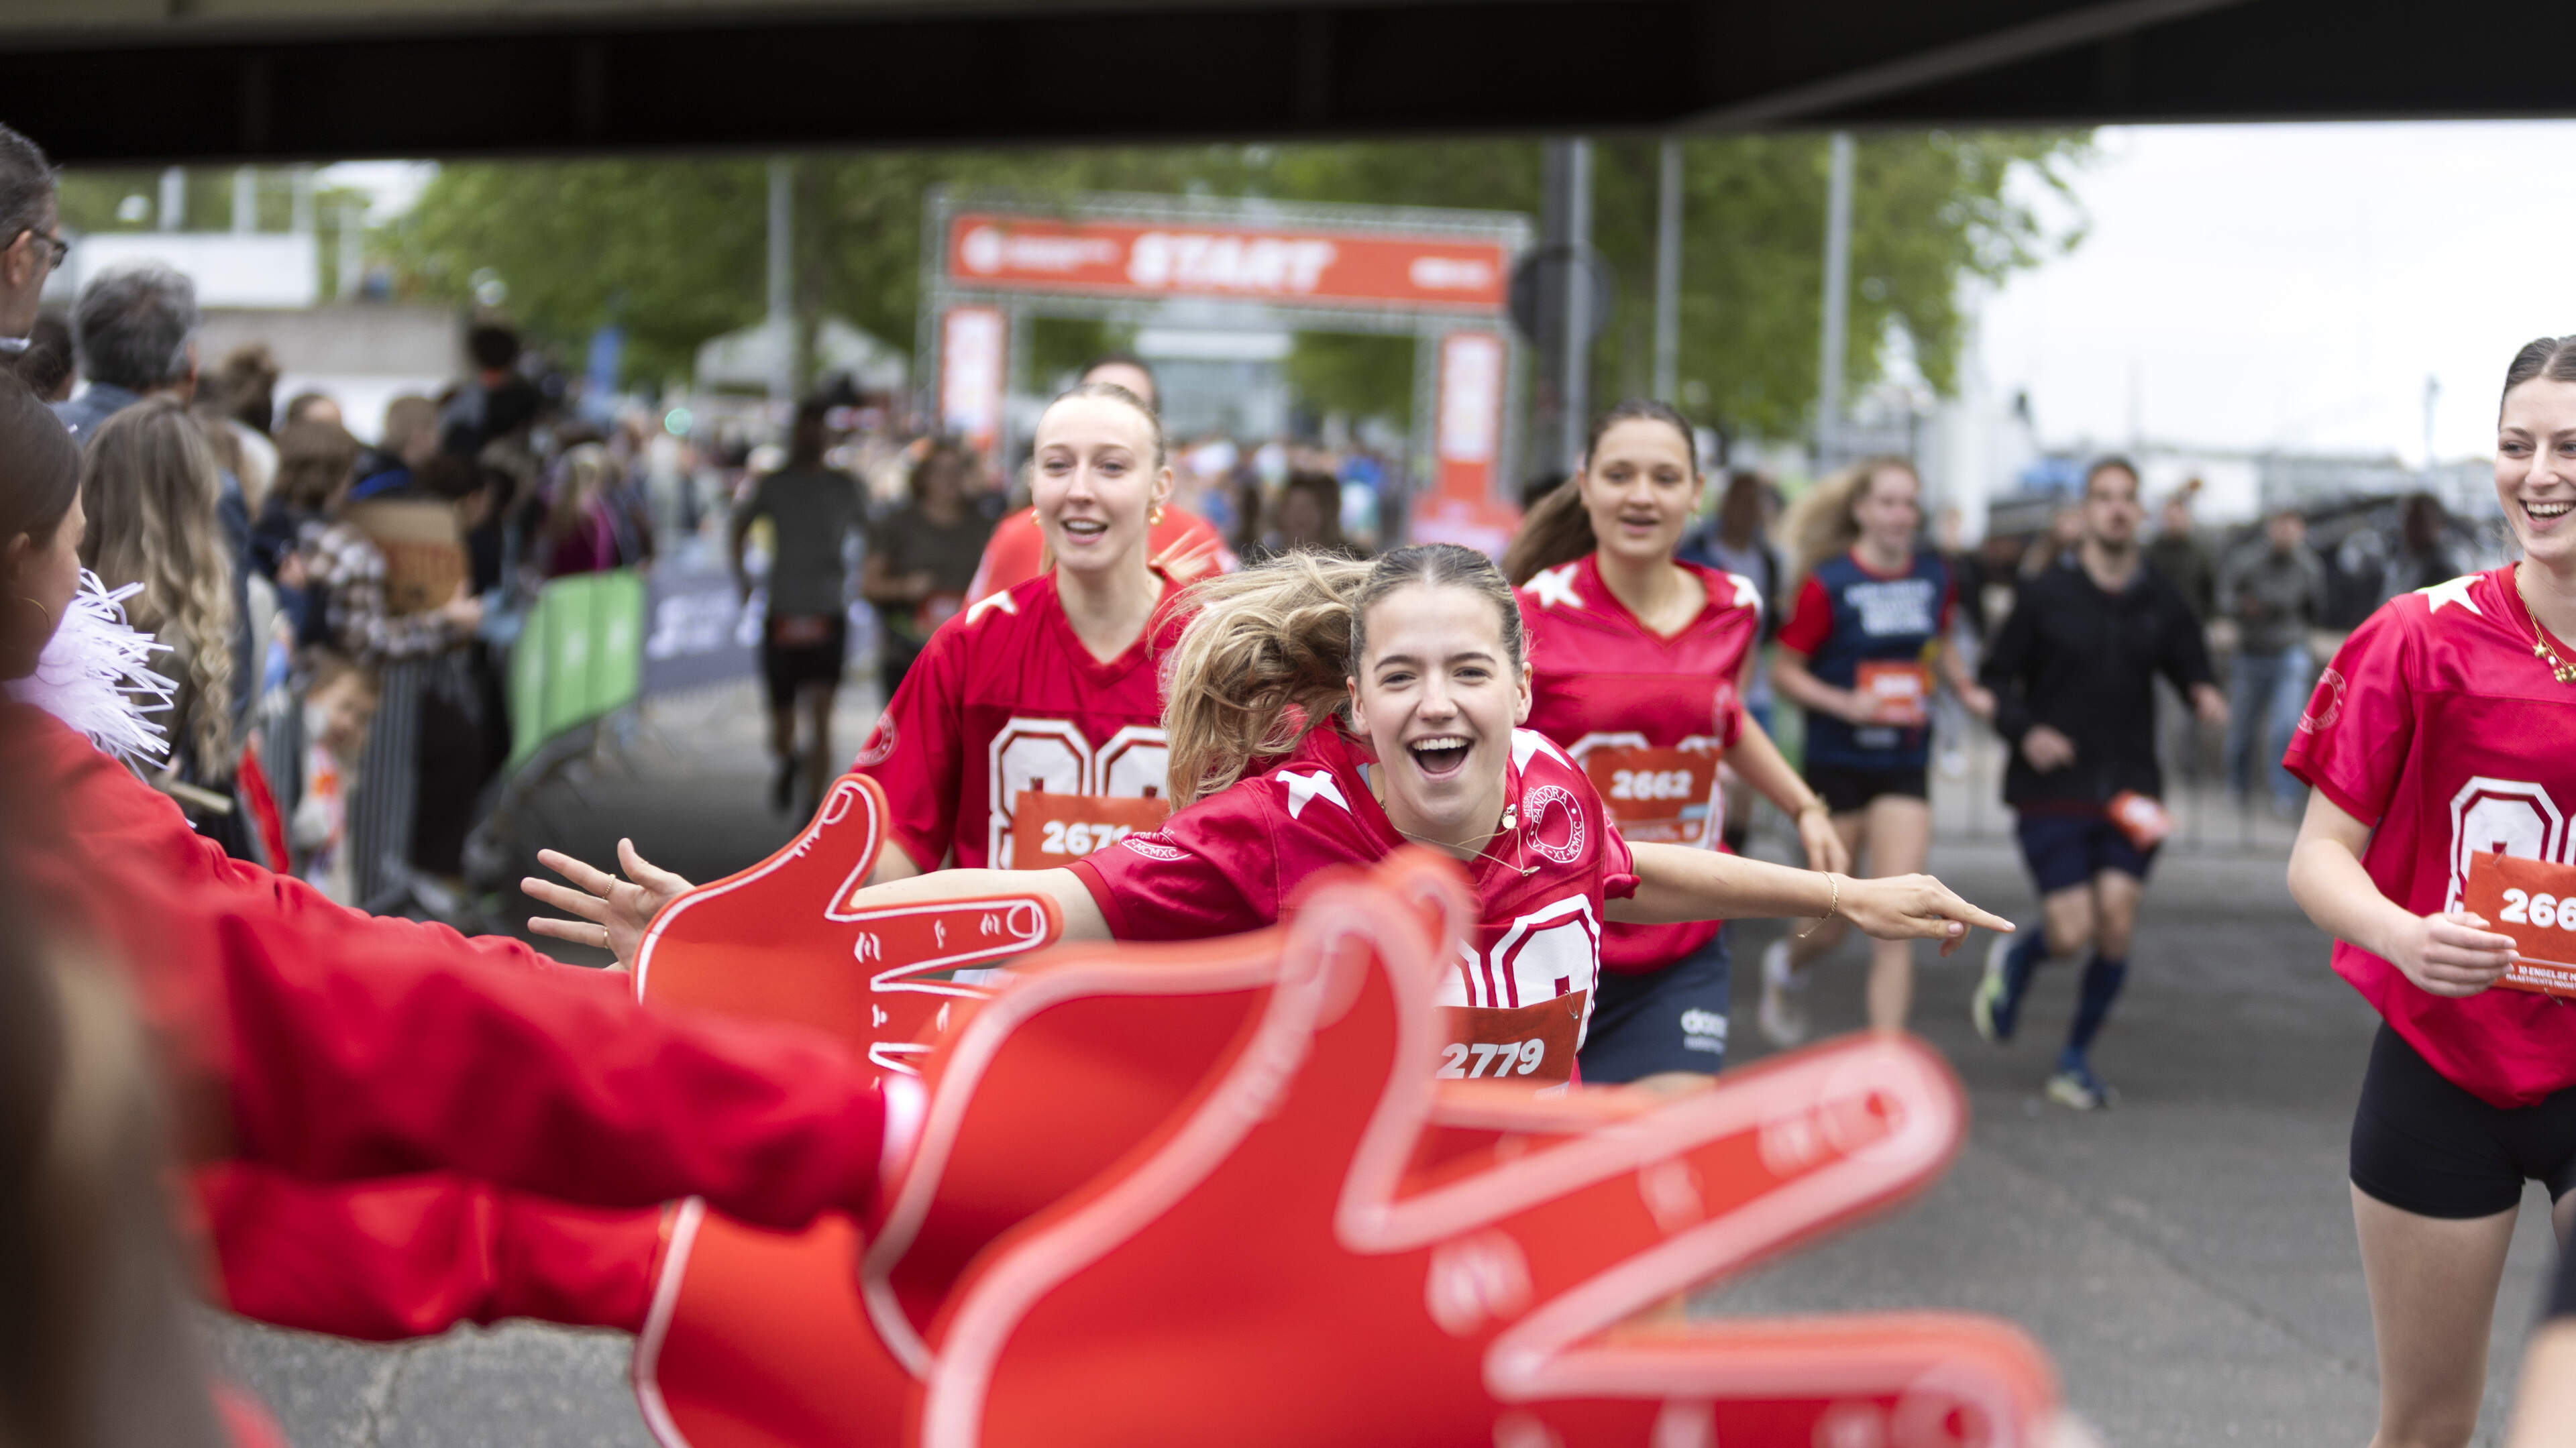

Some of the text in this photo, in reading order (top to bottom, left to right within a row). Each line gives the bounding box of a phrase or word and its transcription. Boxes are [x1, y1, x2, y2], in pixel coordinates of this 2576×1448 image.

[1128, 231, 1336, 294] START
[1610, 770, 1694, 800] 2662
[1533, 787, 1568, 824] PANDORA
[1435, 1038, 1546, 1079] 2779
